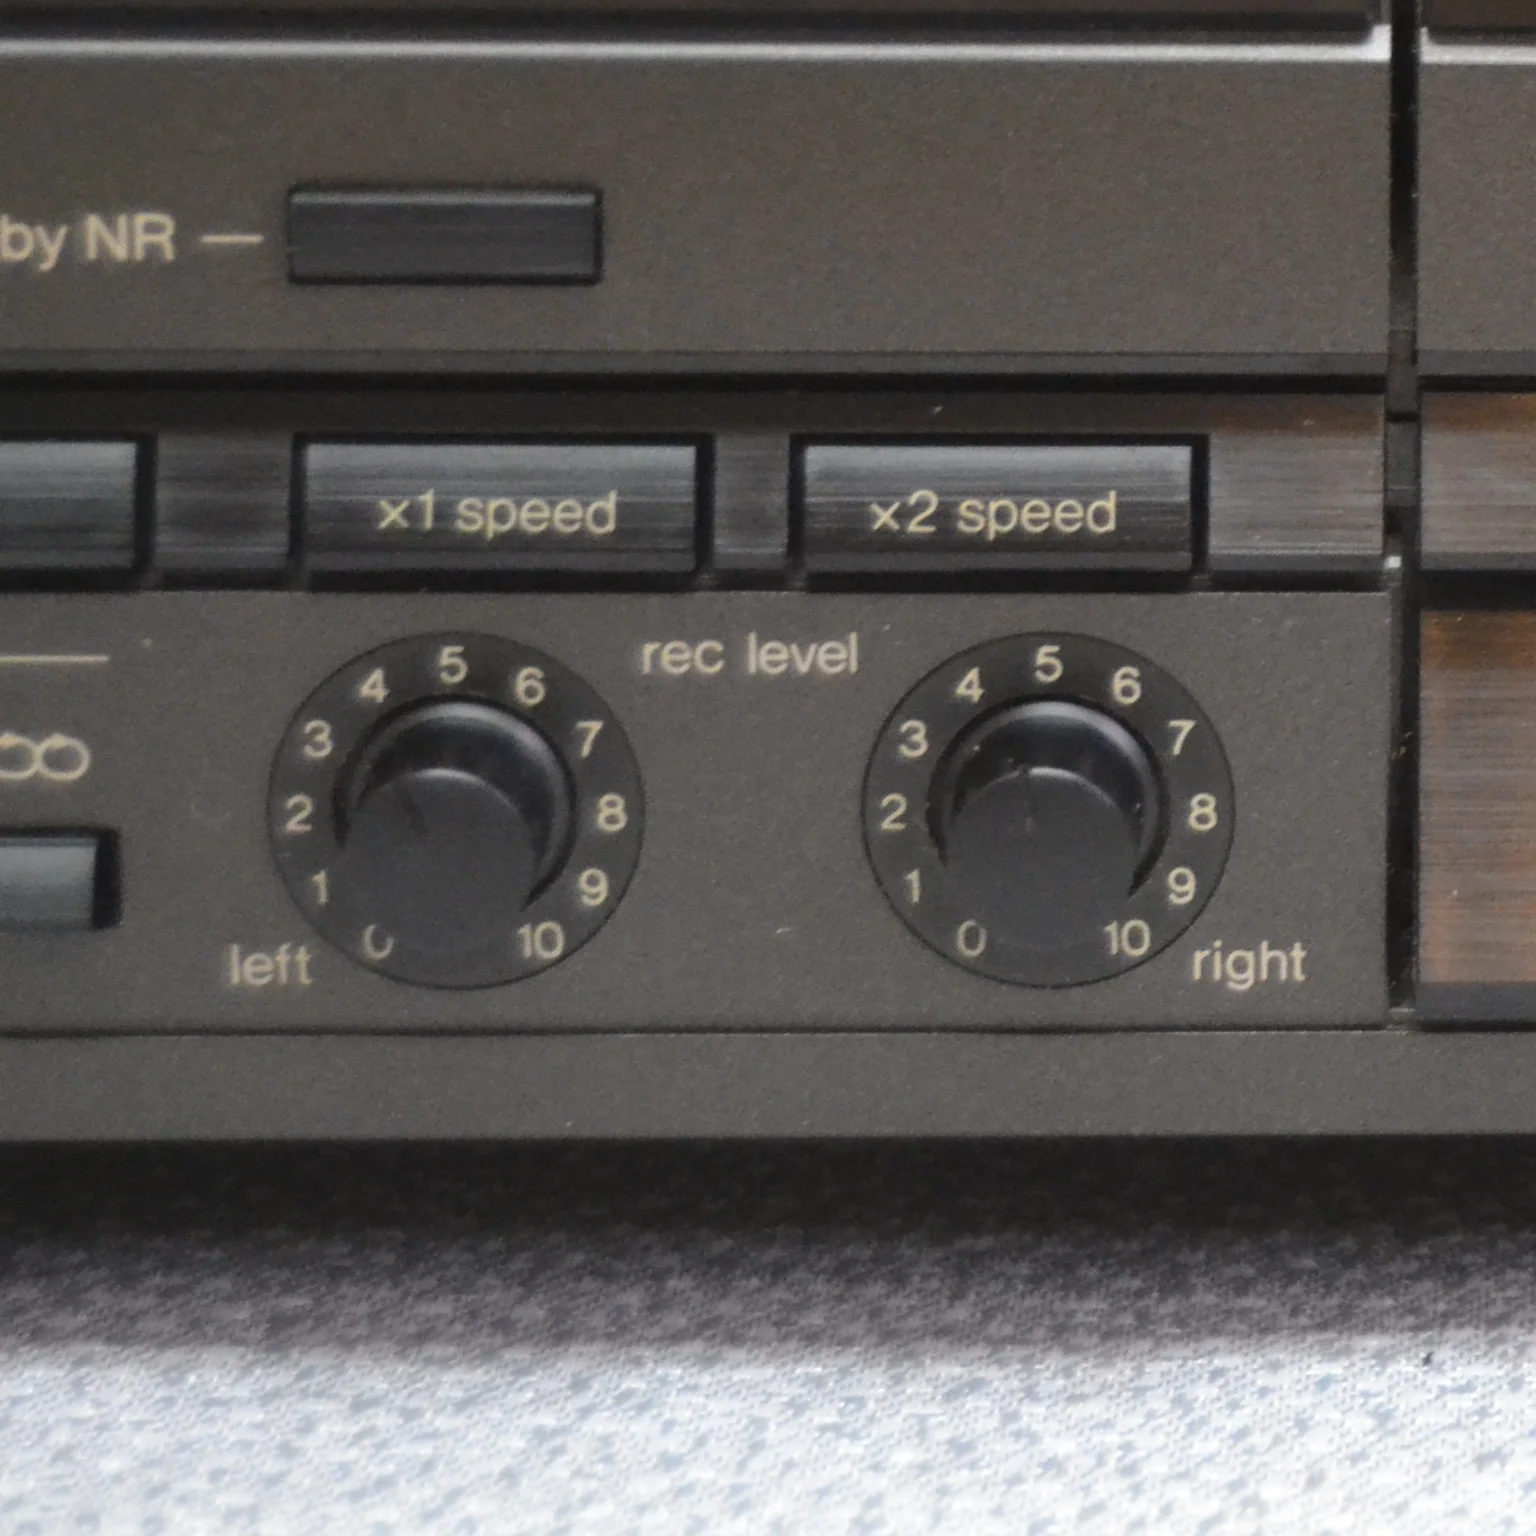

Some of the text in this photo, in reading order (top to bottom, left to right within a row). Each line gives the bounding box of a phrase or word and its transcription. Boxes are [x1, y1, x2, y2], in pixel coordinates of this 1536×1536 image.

[85, 213, 177, 262] NR
[455, 489, 618, 541] speed
[957, 490, 1118, 541] speed
[438, 645, 468, 684] 5
[641, 632, 859, 675] rec level
[1034, 645, 1064, 682] 5
[356, 667, 389, 704] 4
[513, 667, 547, 706] 6
[955, 668, 985, 704] 4
[1111, 667, 1142, 704] 6
[302, 719, 334, 759] 3
[575, 720, 604, 759] 7
[900, 720, 929, 758] 3
[1166, 720, 1196, 756] 7
[284, 794, 314, 833] 2
[596, 794, 628, 833] 8
[879, 793, 908, 831] 2
[1188, 794, 1218, 832] 8
[310, 870, 329, 905] 1
[577, 868, 609, 908] 9
[905, 870, 921, 904] 1
[1167, 867, 1196, 906] 9
[362, 923, 394, 961] 0
[516, 921, 565, 960] 10
[956, 920, 987, 958] 0
[1103, 919, 1151, 958] 10
[228, 943, 313, 987] left
[1191, 939, 1307, 991] right
